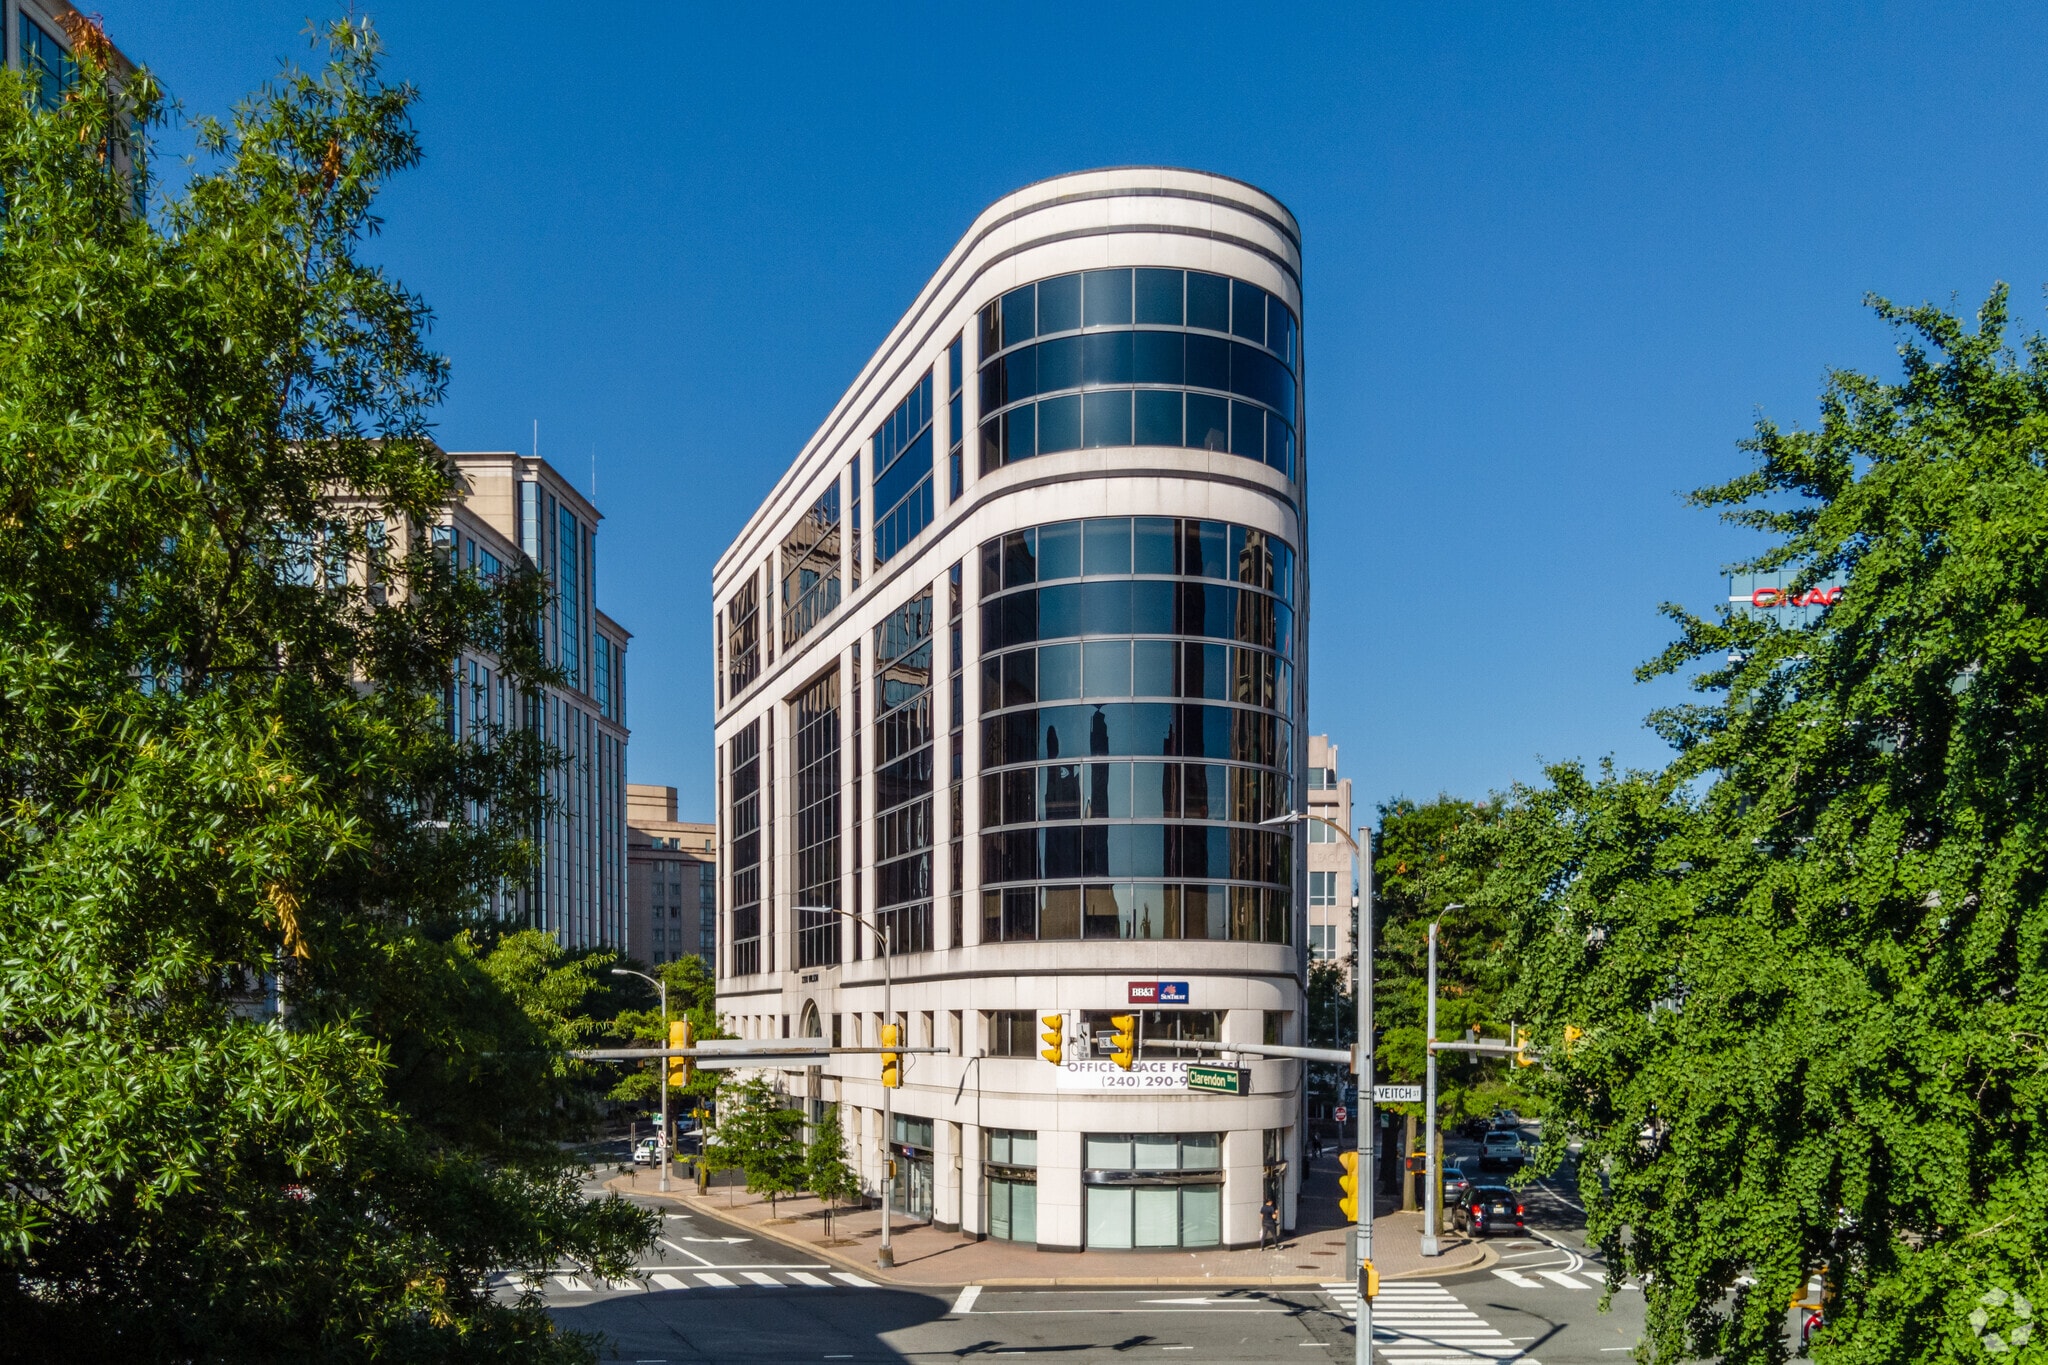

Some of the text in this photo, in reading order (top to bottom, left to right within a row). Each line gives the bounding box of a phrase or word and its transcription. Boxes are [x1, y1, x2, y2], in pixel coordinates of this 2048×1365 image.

[1131, 987, 1156, 997] BB&T
[1067, 1062, 1115, 1073] OFFICE
[1122, 1062, 1166, 1073] PACE
[1101, 1075, 1141, 1088] (240)
[1189, 1070, 1237, 1087] Clarendon Blvd
[1378, 1087, 1412, 1099] VEITCH
